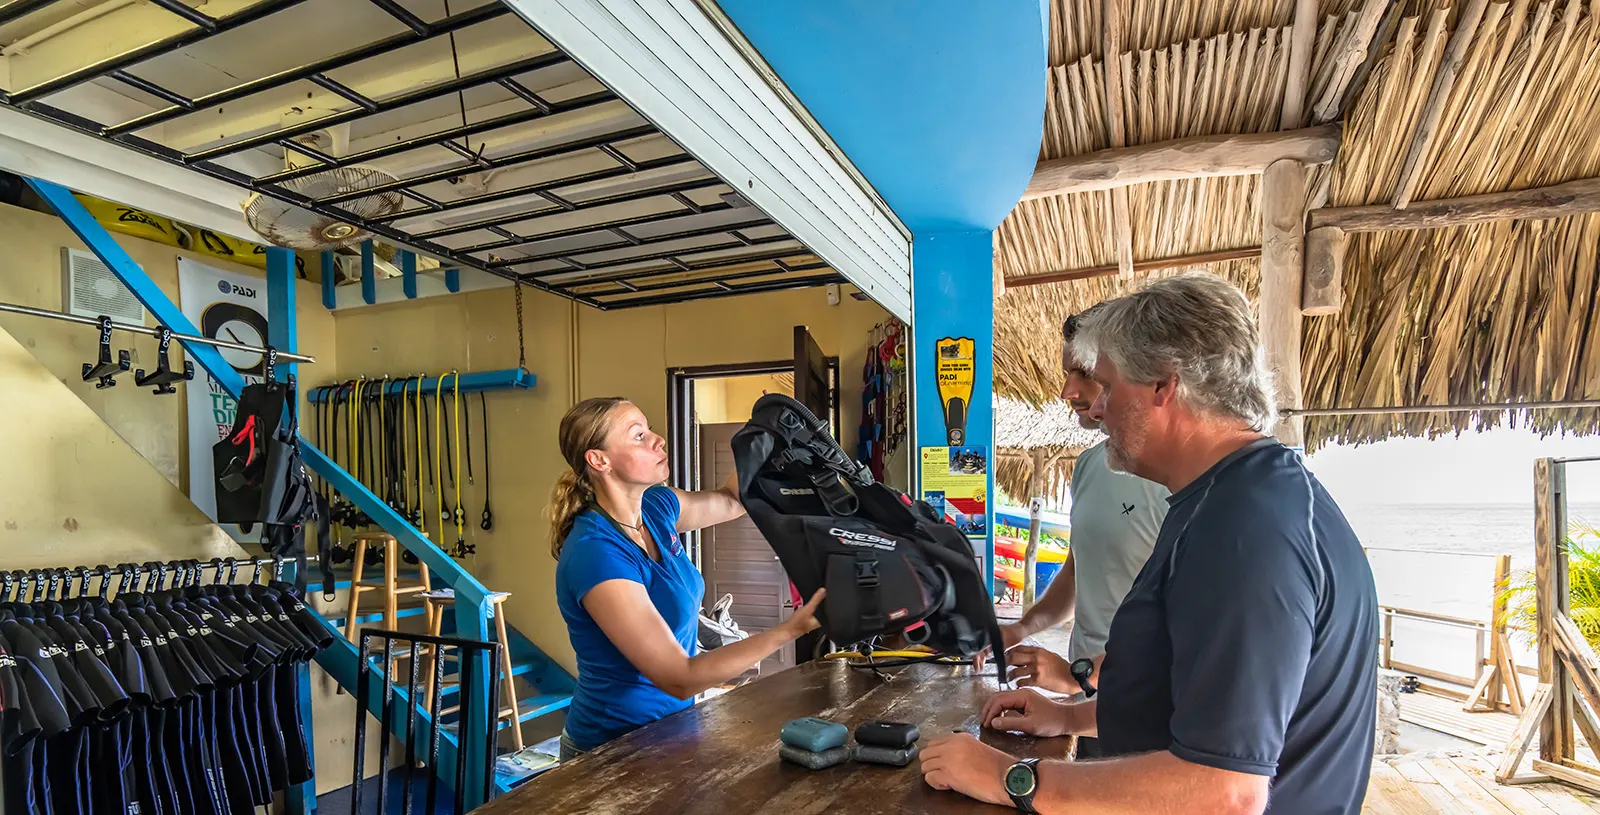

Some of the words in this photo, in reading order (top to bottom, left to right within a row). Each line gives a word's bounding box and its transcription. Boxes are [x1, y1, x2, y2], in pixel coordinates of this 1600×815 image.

[232, 284, 257, 299] PADI
[209, 393, 239, 411] TE
[828, 527, 897, 547] CRESSI
